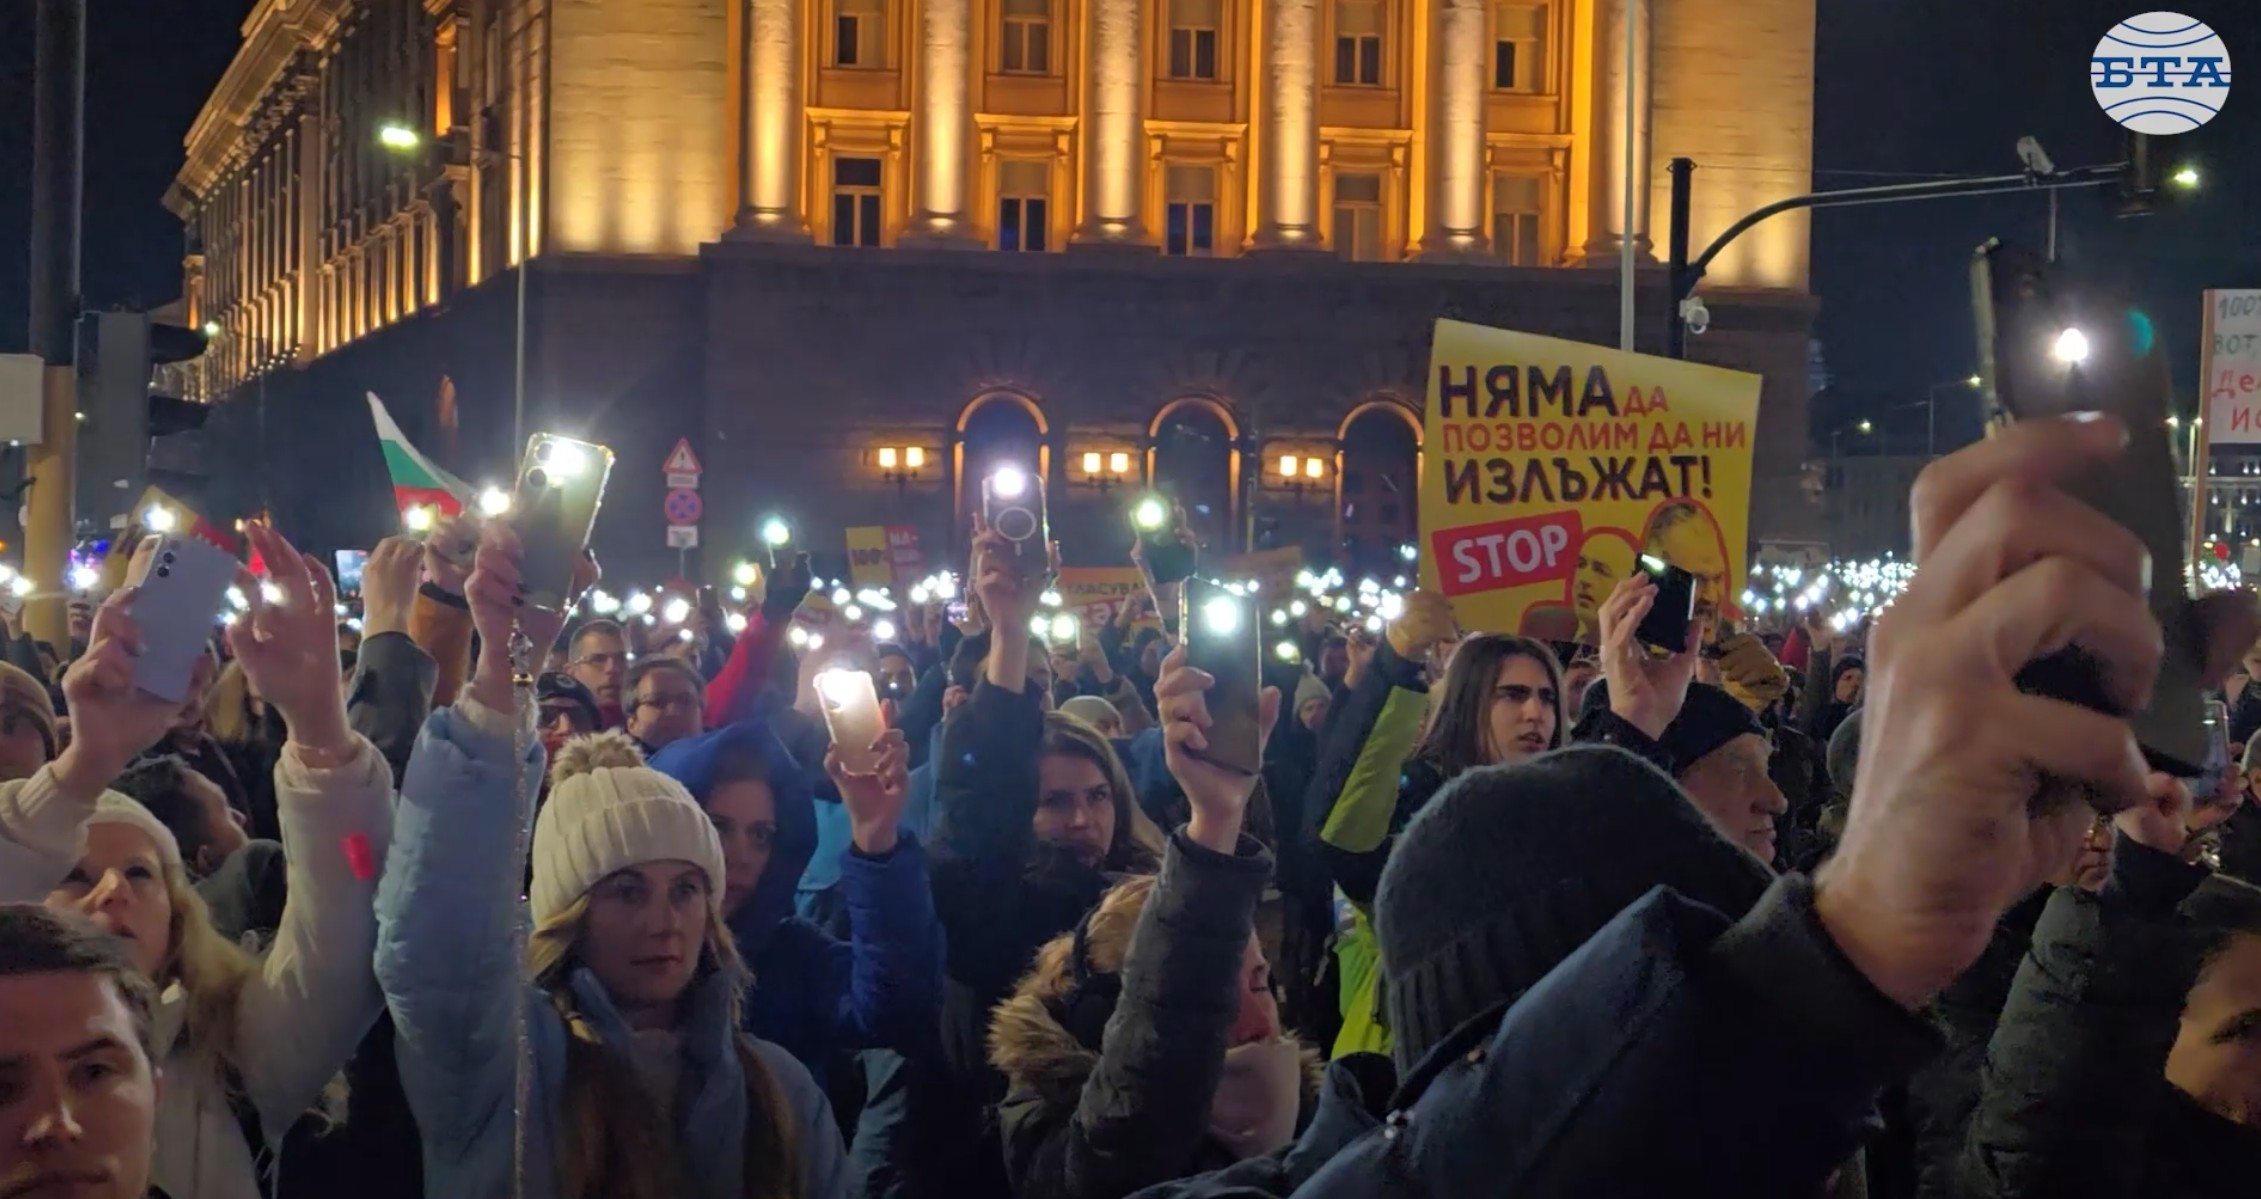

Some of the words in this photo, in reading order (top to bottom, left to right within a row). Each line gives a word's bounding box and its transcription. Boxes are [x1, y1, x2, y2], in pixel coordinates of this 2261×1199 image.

[2218, 294, 2261, 320] 100
[1438, 365, 1618, 418] НЯМА
[1622, 385, 1669, 417] ДА
[2213, 369, 2261, 399] Де
[1443, 421, 1639, 453] ПОЗВОЛИМ
[1648, 422, 1694, 454] ДА
[1702, 421, 1746, 449] НИ
[1443, 456, 1713, 504] ИЗЛЪЖАТ!
[1453, 524, 1568, 583] STOP
